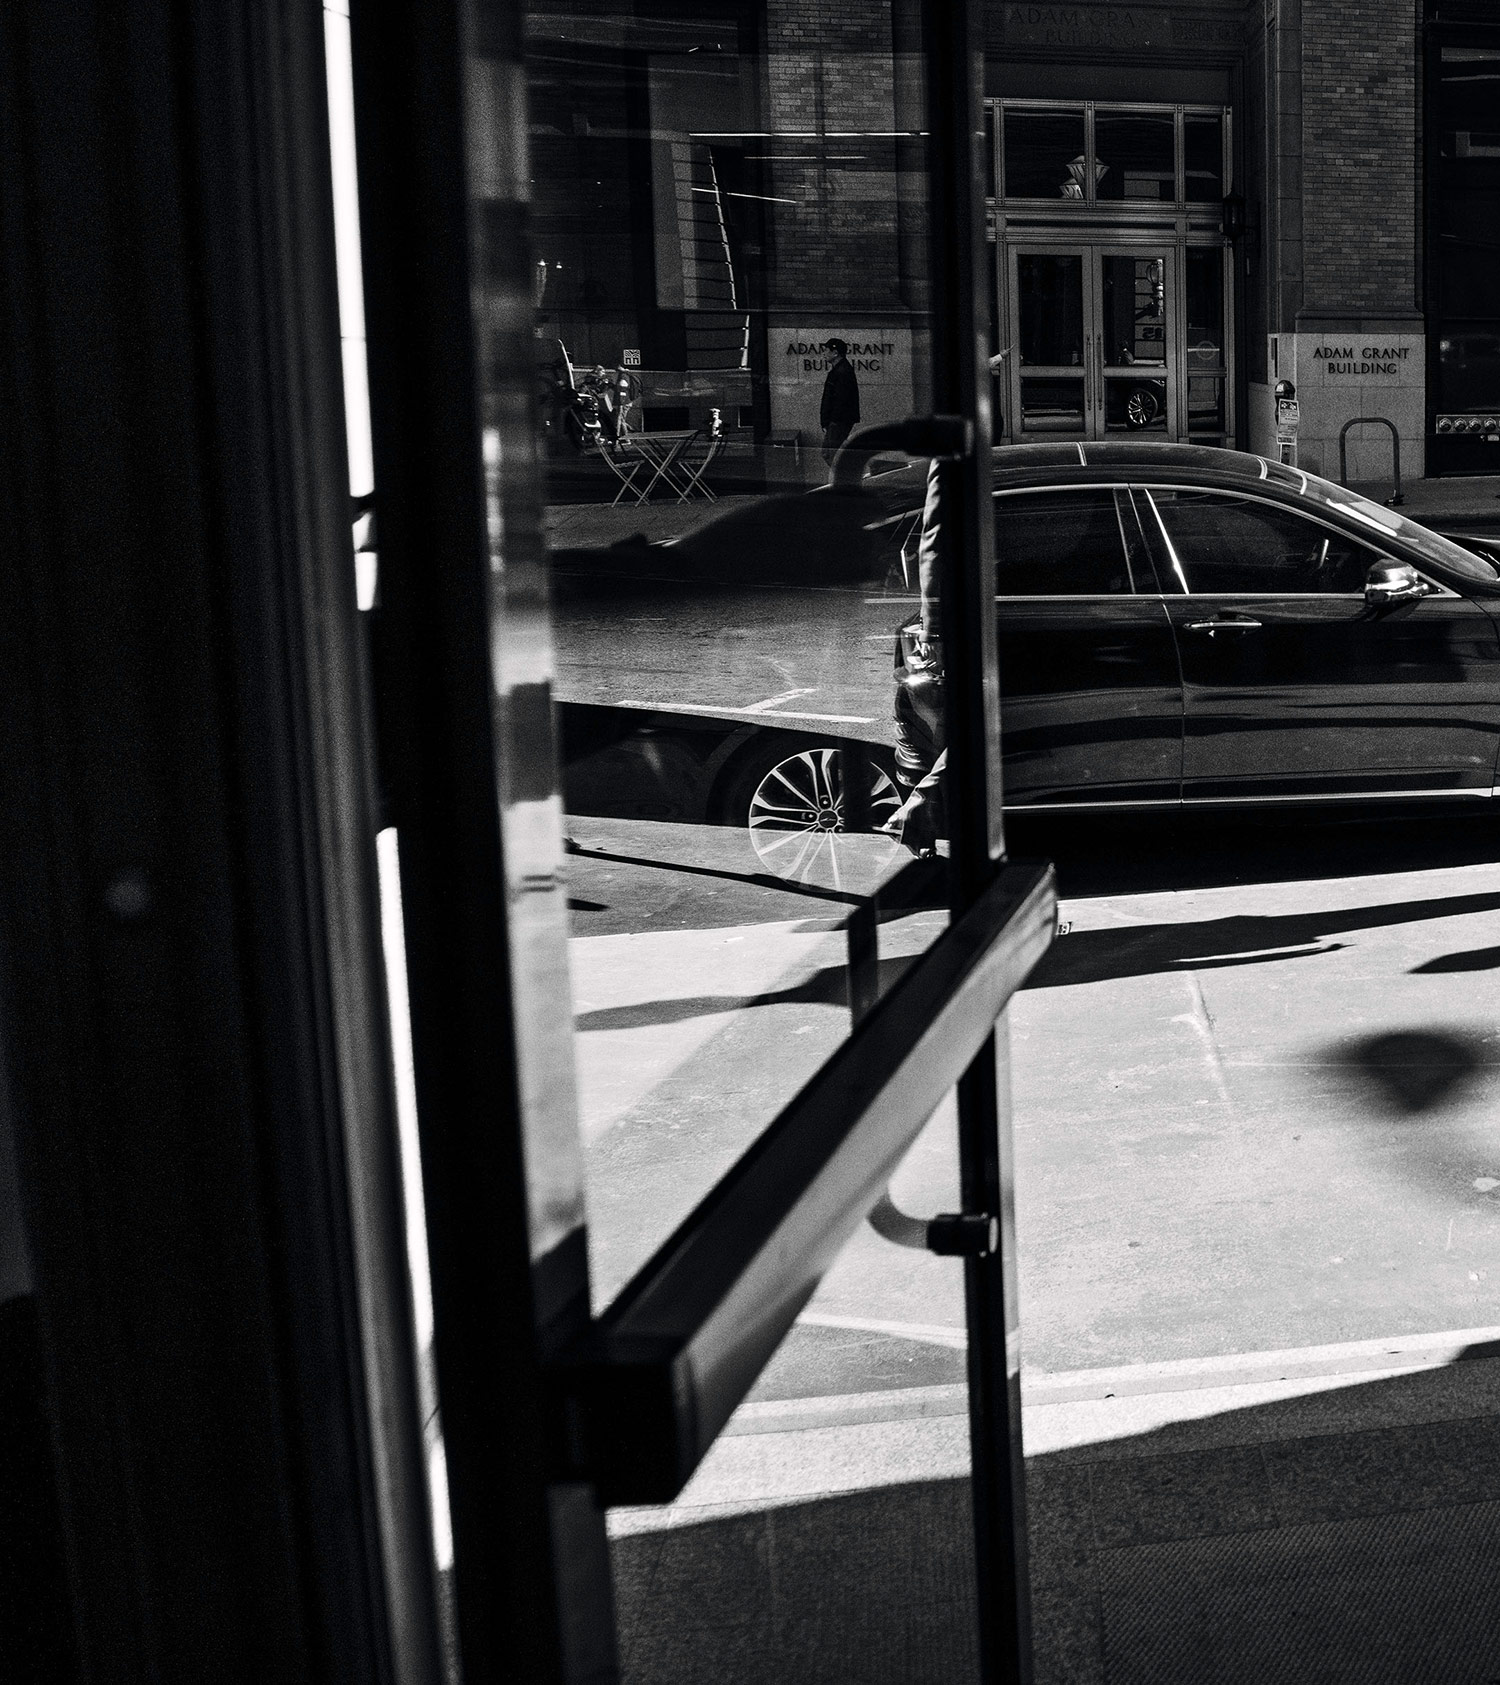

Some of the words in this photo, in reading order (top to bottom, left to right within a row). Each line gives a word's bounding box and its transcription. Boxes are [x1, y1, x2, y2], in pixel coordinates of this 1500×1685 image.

[1009, 7, 1078, 26] ADAM
[844, 343, 894, 356] GRANT
[1313, 347, 1353, 359] ADAM
[1362, 347, 1410, 359] GRANT
[804, 359, 880, 371] BUIING
[1328, 362, 1397, 375] BUILDING
